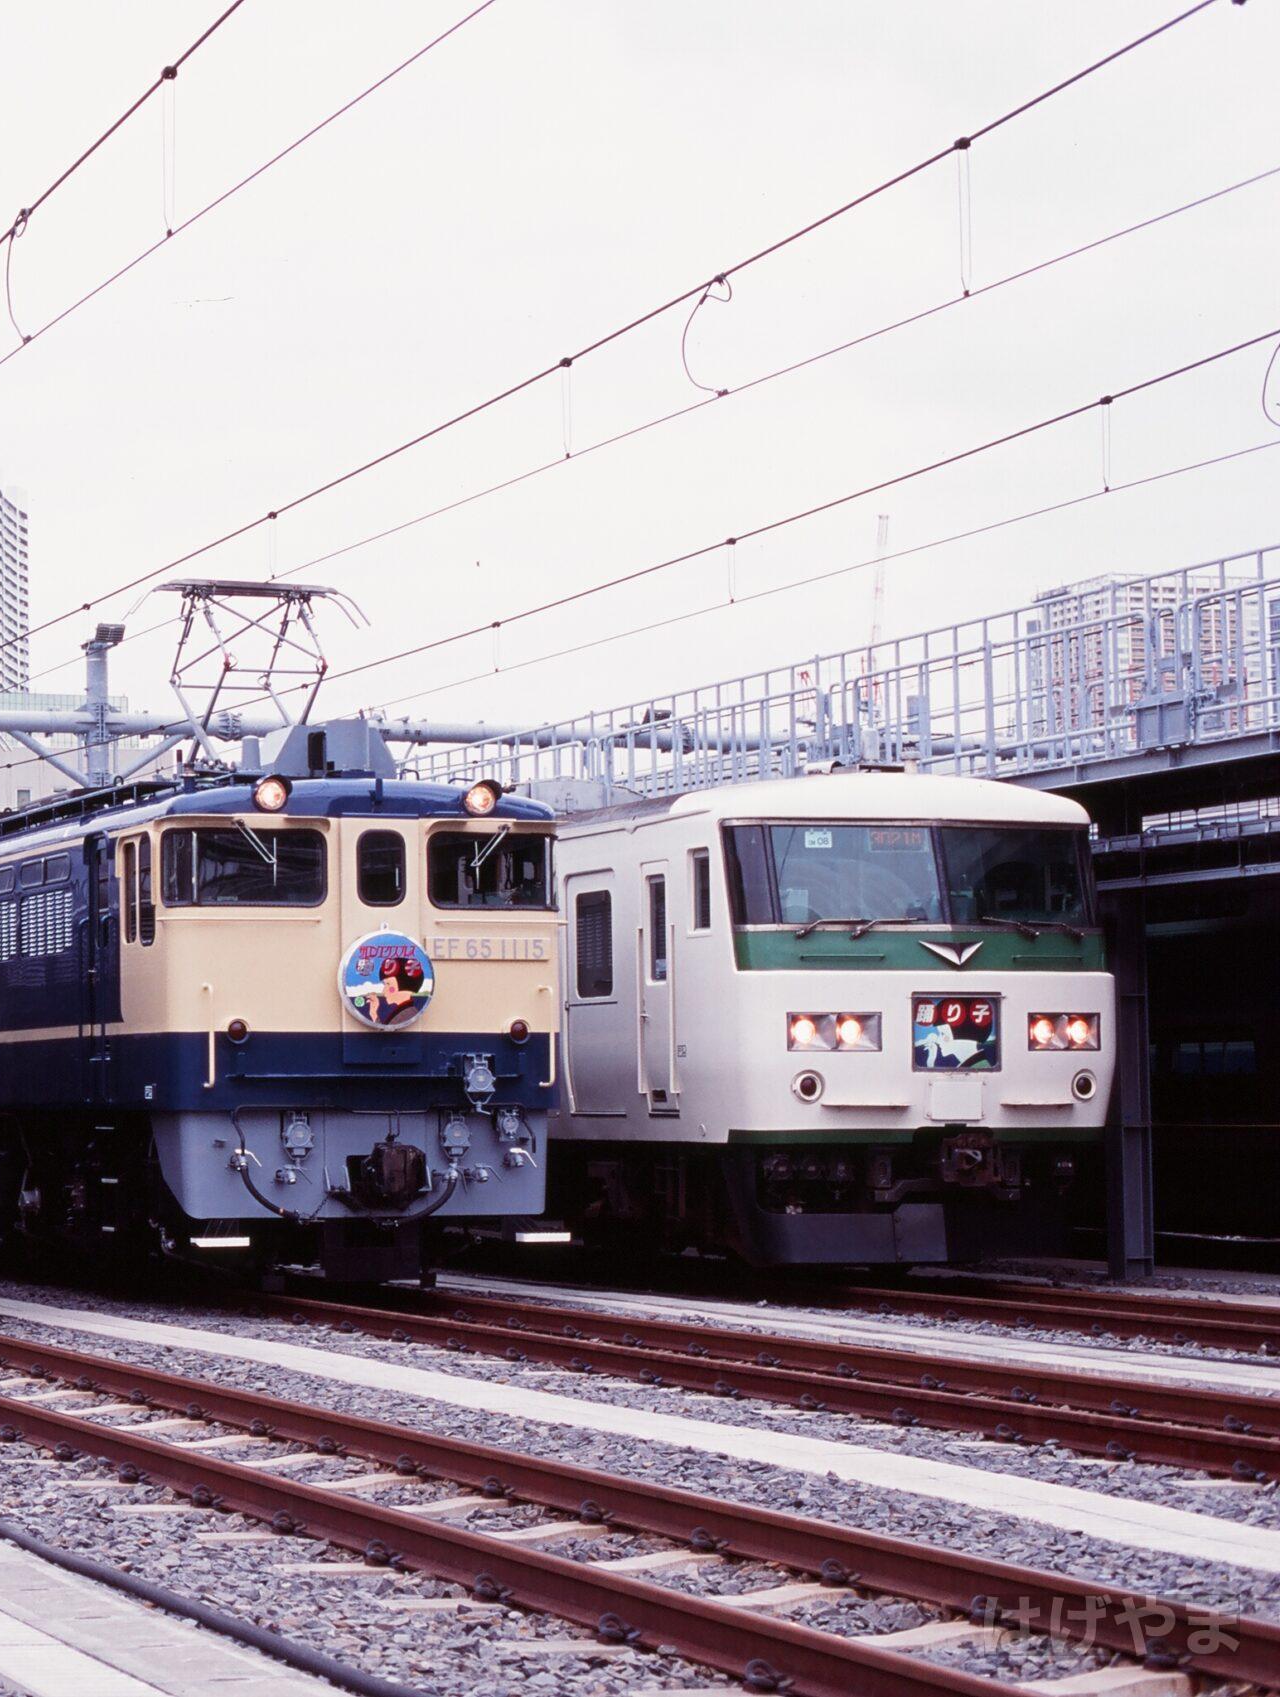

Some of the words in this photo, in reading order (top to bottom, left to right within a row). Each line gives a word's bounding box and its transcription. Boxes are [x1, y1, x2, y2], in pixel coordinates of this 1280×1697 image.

[433, 937, 461, 959] EF
[466, 938, 492, 959] 65
[501, 938, 545, 959] 1115
